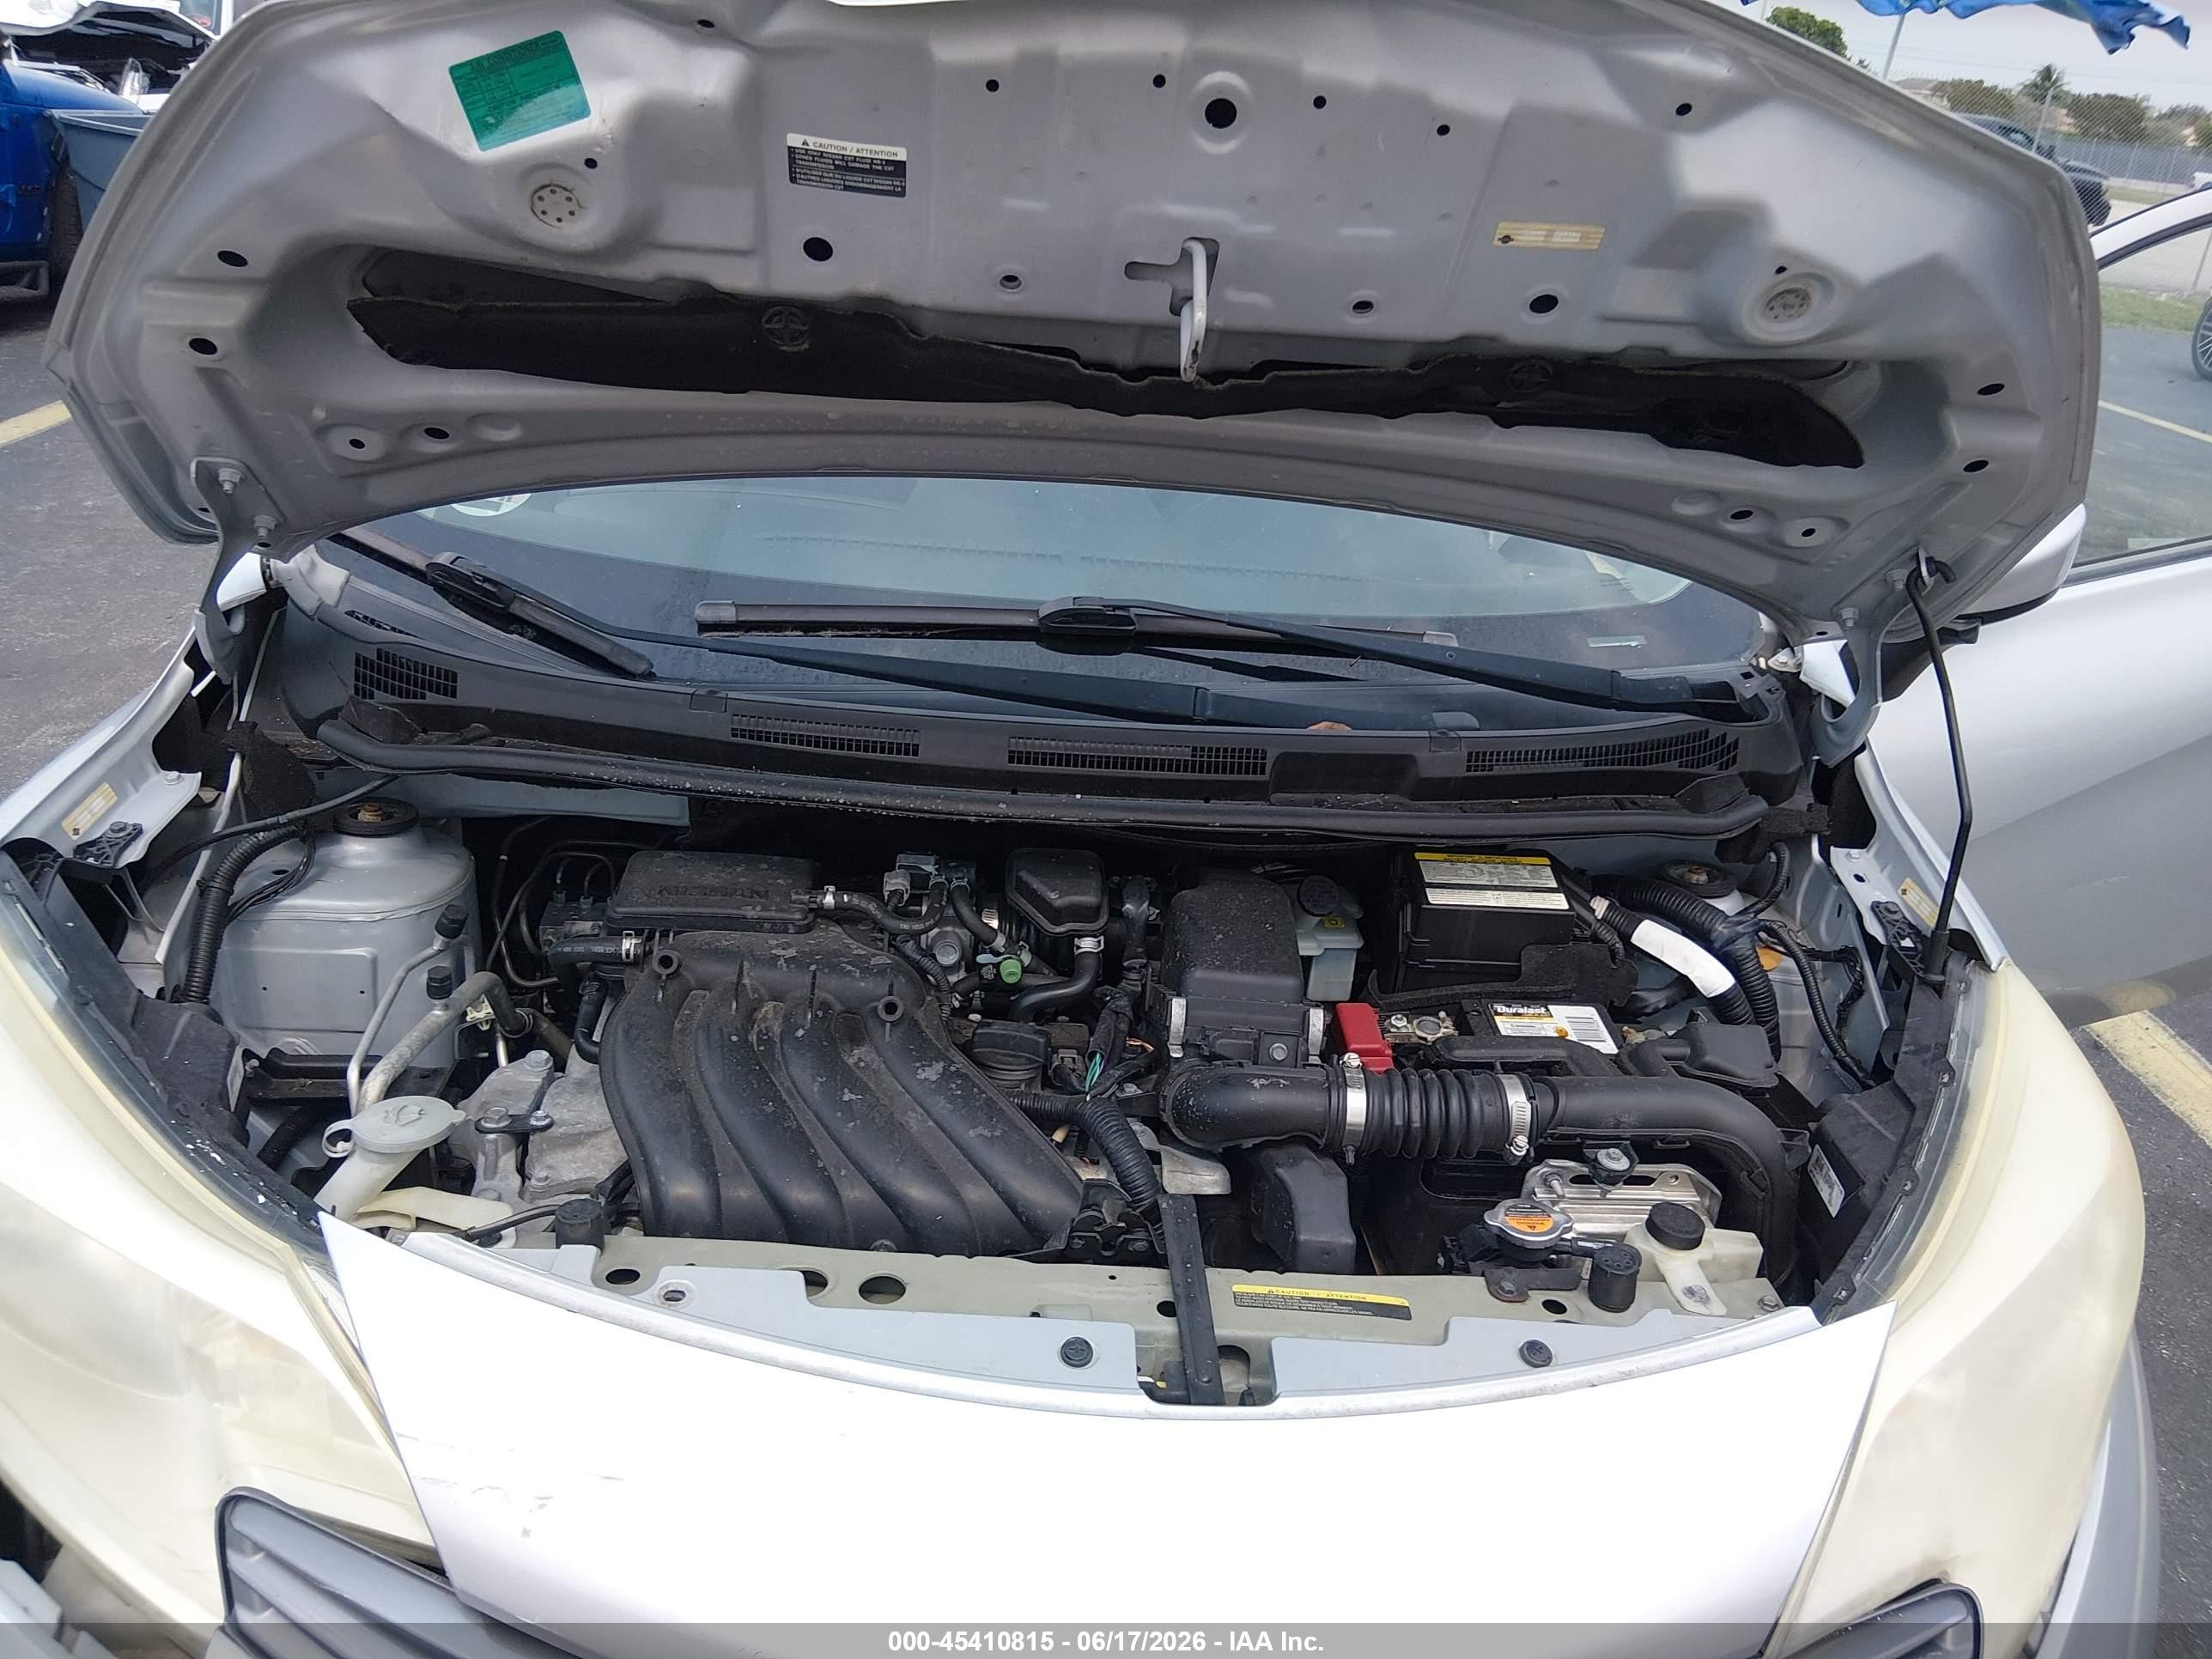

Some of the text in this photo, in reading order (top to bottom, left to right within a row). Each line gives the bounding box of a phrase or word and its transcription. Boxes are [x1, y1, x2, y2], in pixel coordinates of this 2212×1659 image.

[812, 142, 848, 152] CAUTION
[856, 148, 898, 158] ATTENTION
[1493, 1005, 1547, 1014] Duralast
[1326, 1292, 1367, 1301] ATTENTION
